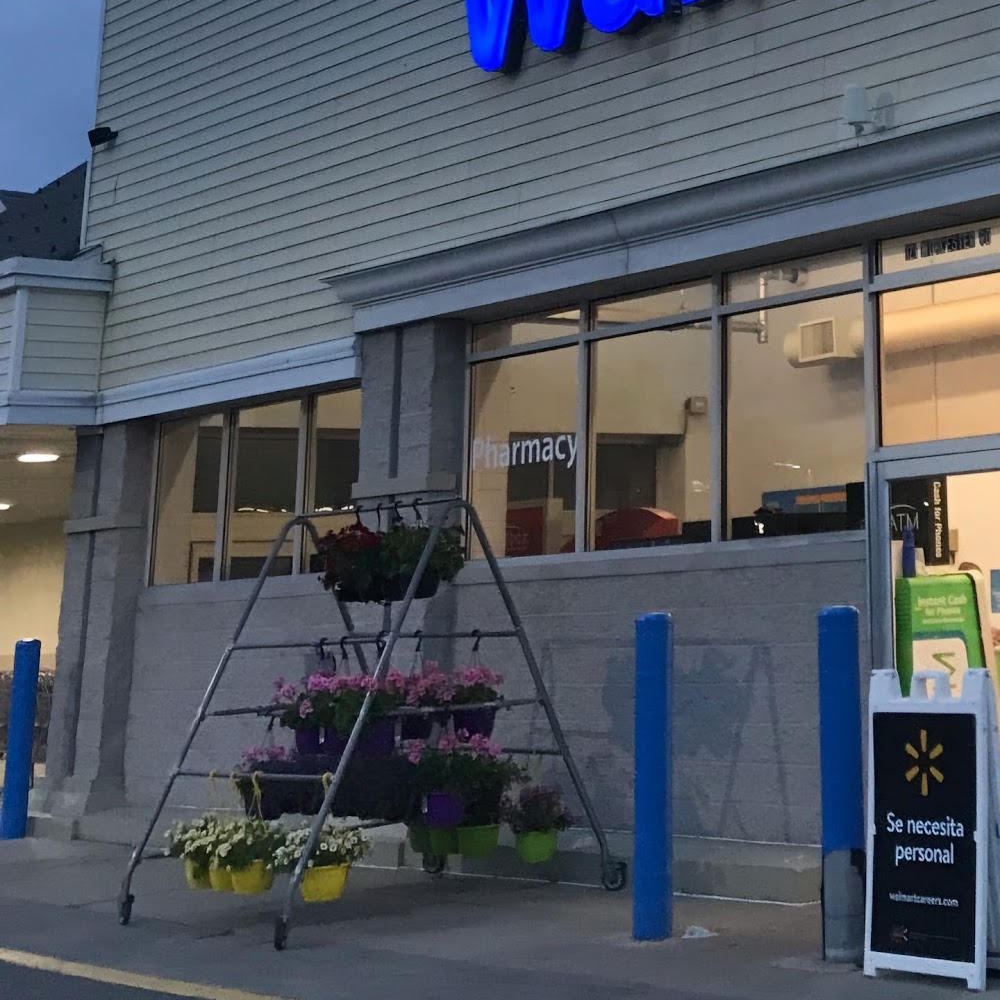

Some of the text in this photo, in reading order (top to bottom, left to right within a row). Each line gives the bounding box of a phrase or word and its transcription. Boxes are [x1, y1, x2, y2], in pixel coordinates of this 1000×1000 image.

[473, 434, 577, 469] Pharmacy
[934, 507, 942, 522] for
[935, 523, 943, 558] Phones
[886, 811, 965, 838] Se necesita
[895, 842, 954, 866] personal
[889, 891, 960, 907] walmartcareers.com
